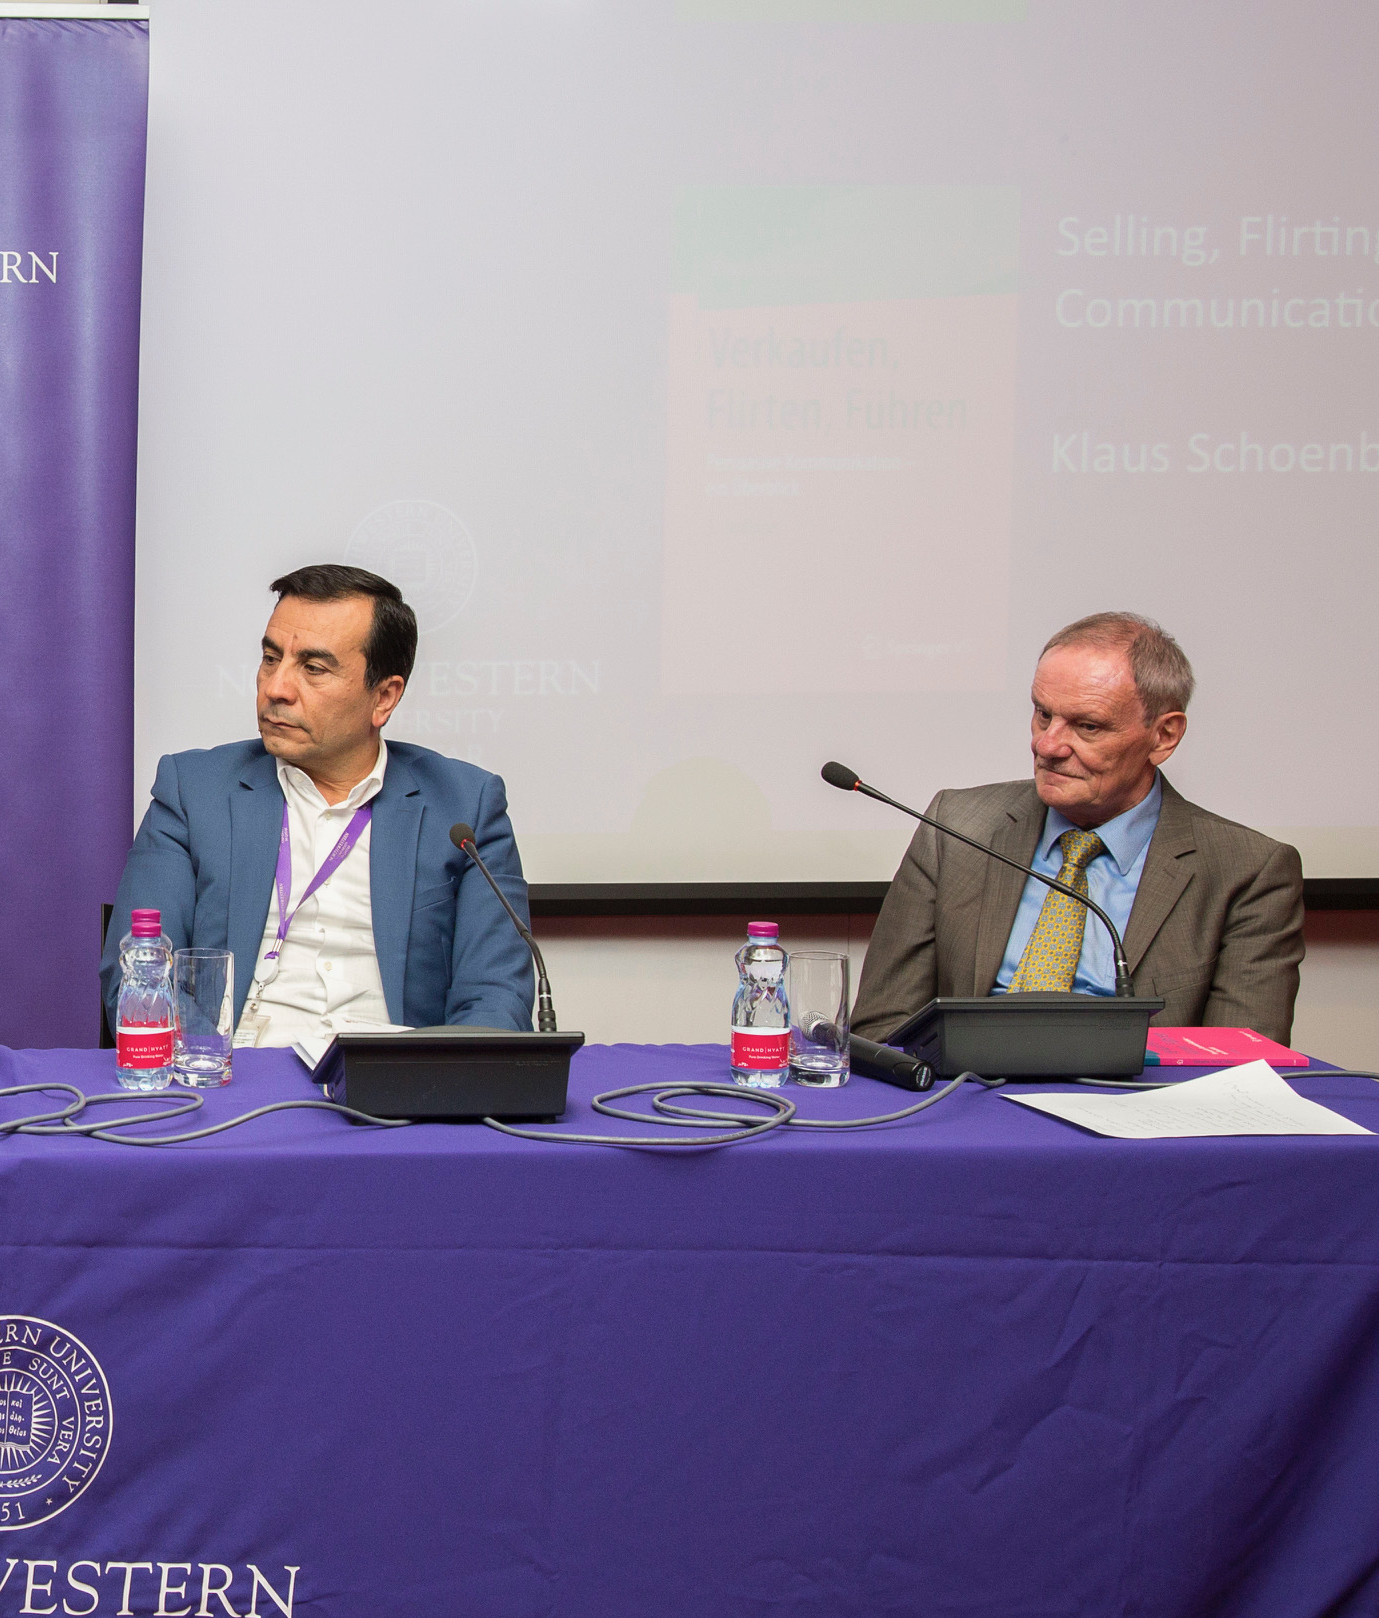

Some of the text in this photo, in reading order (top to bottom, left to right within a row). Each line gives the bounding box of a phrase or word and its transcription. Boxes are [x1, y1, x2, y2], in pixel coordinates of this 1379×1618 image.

[1056, 213, 1379, 267] Selling, Flirtin
[1052, 430, 1171, 473] Klaus
[28, 1357, 70, 1400] SUNT
[50, 1336, 104, 1493] UNIVERSITY
[46, 1416, 75, 1466] VERA
